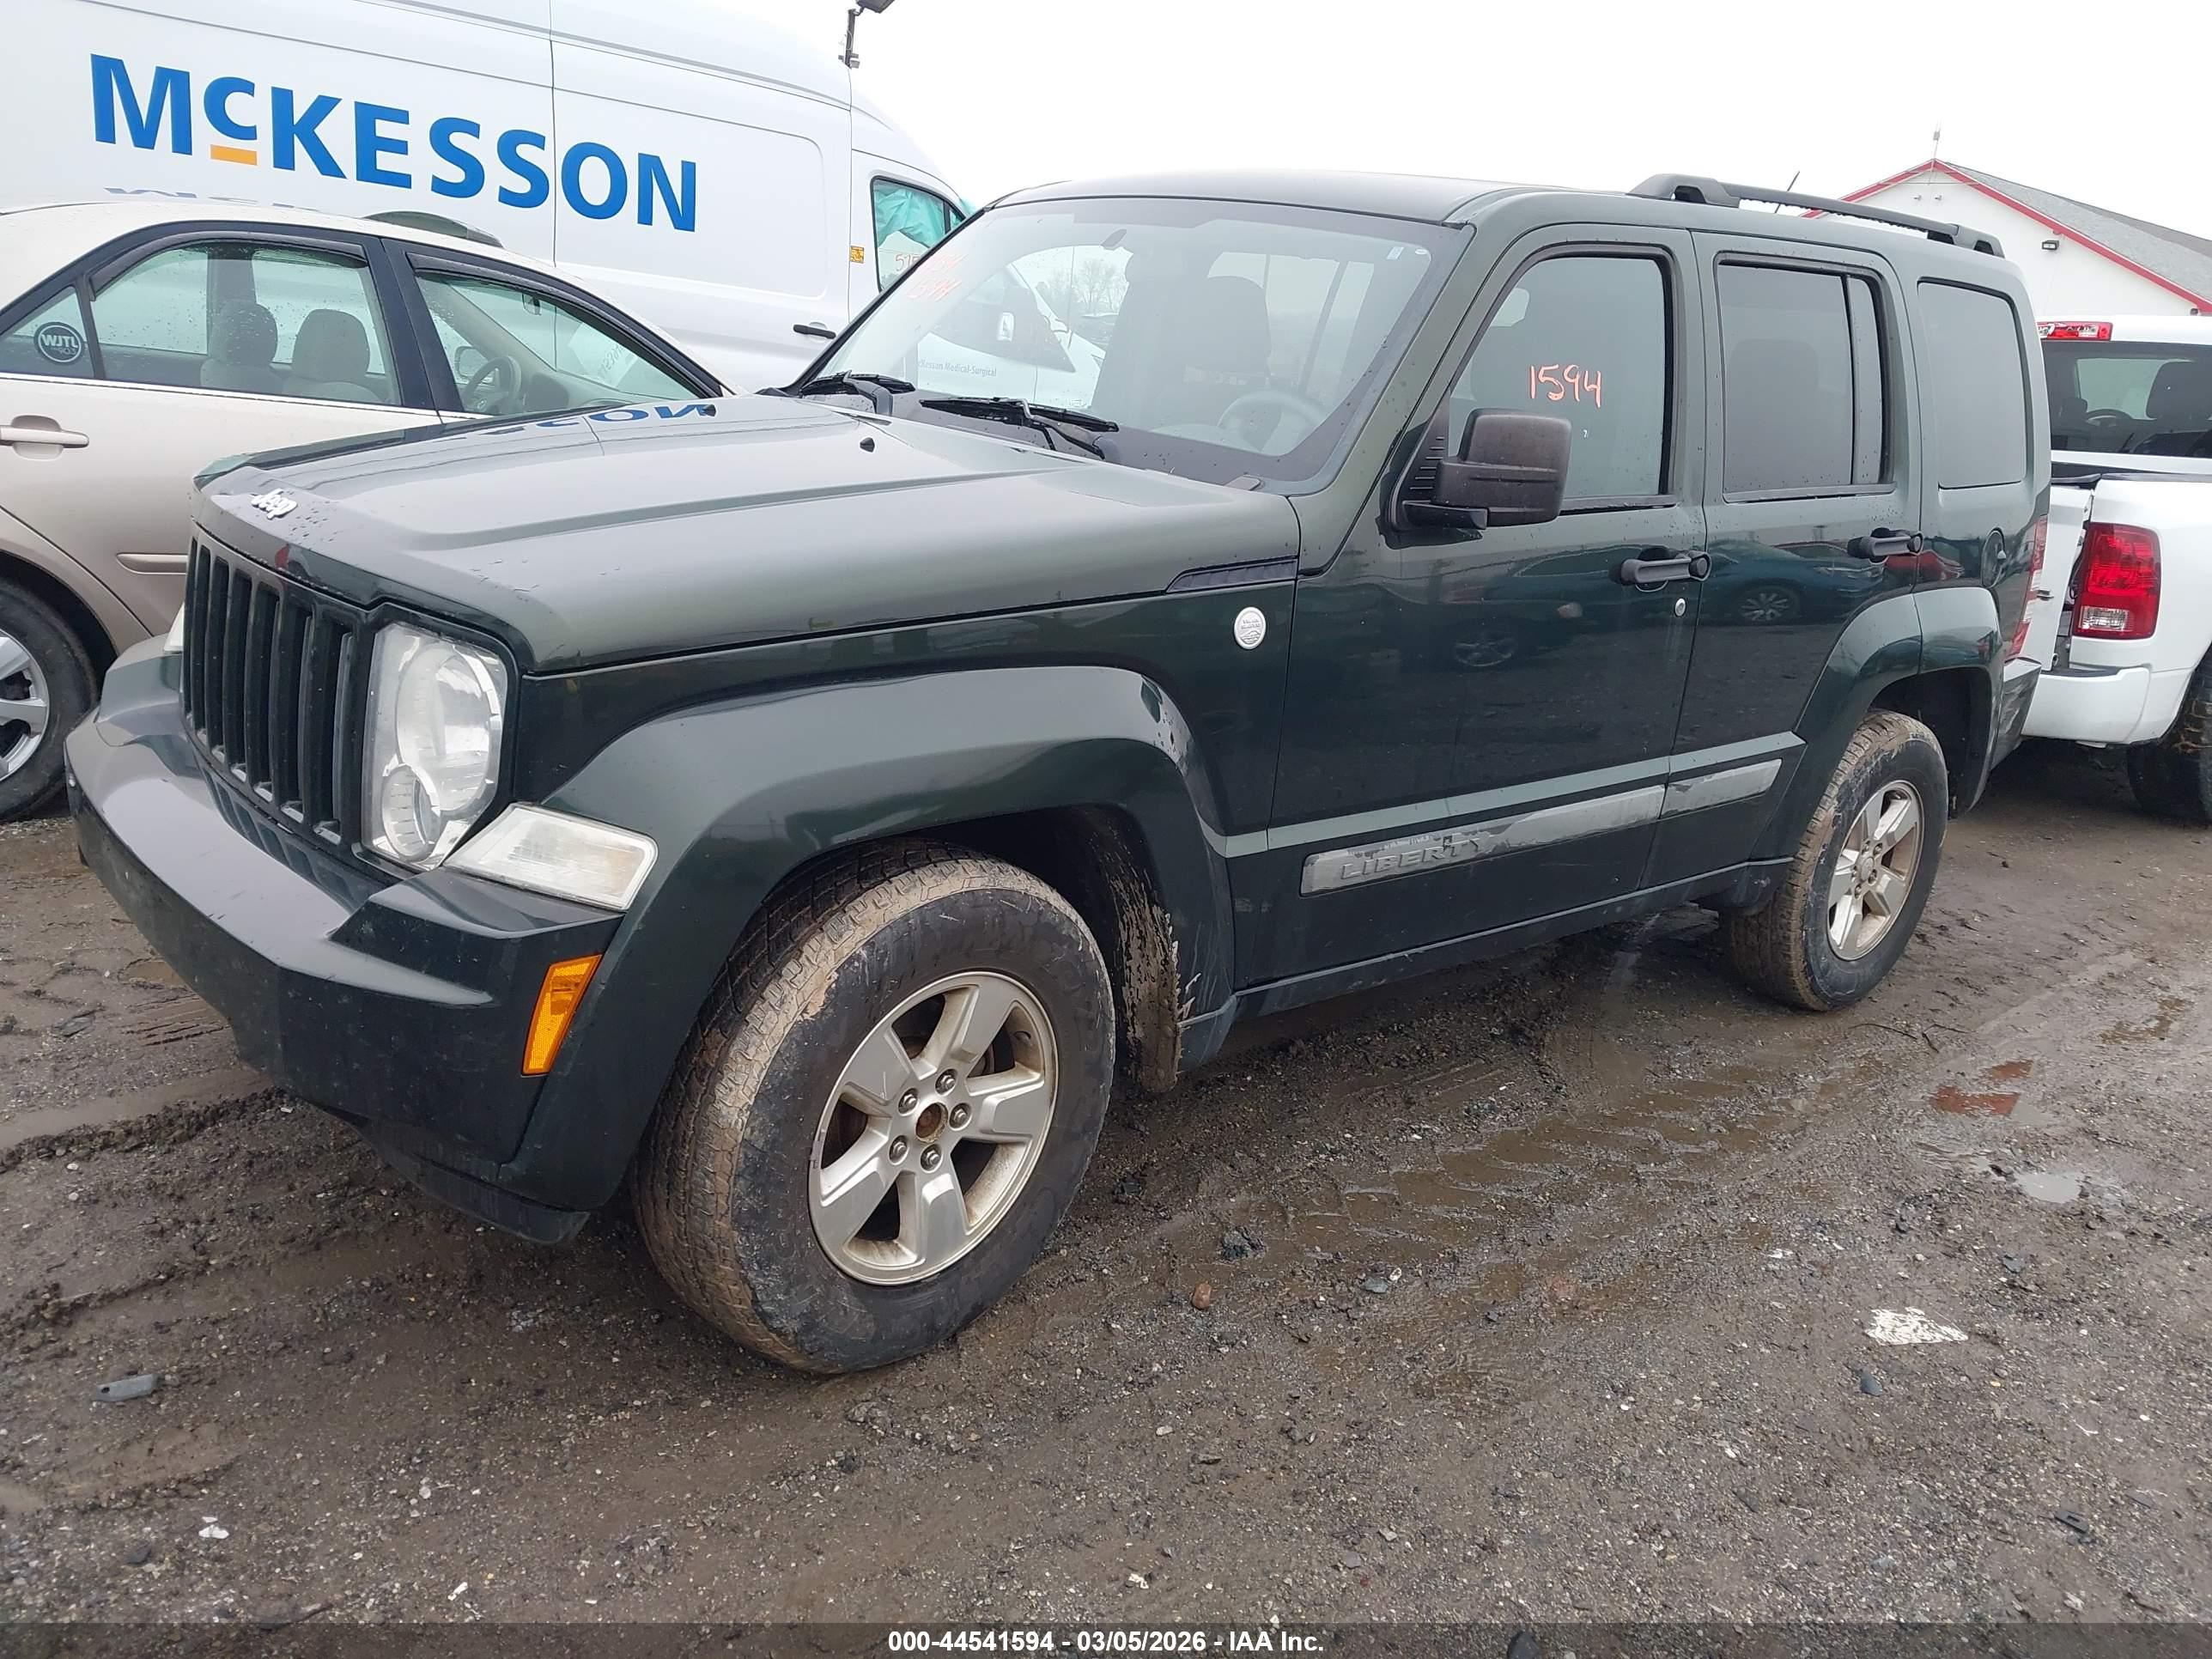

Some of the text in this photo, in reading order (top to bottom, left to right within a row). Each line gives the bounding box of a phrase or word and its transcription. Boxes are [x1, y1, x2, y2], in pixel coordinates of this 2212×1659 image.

[41, 334, 78, 348] WJTL
[1530, 364, 1601, 408] 1594
[1340, 833, 1492, 880] LIBERTY
